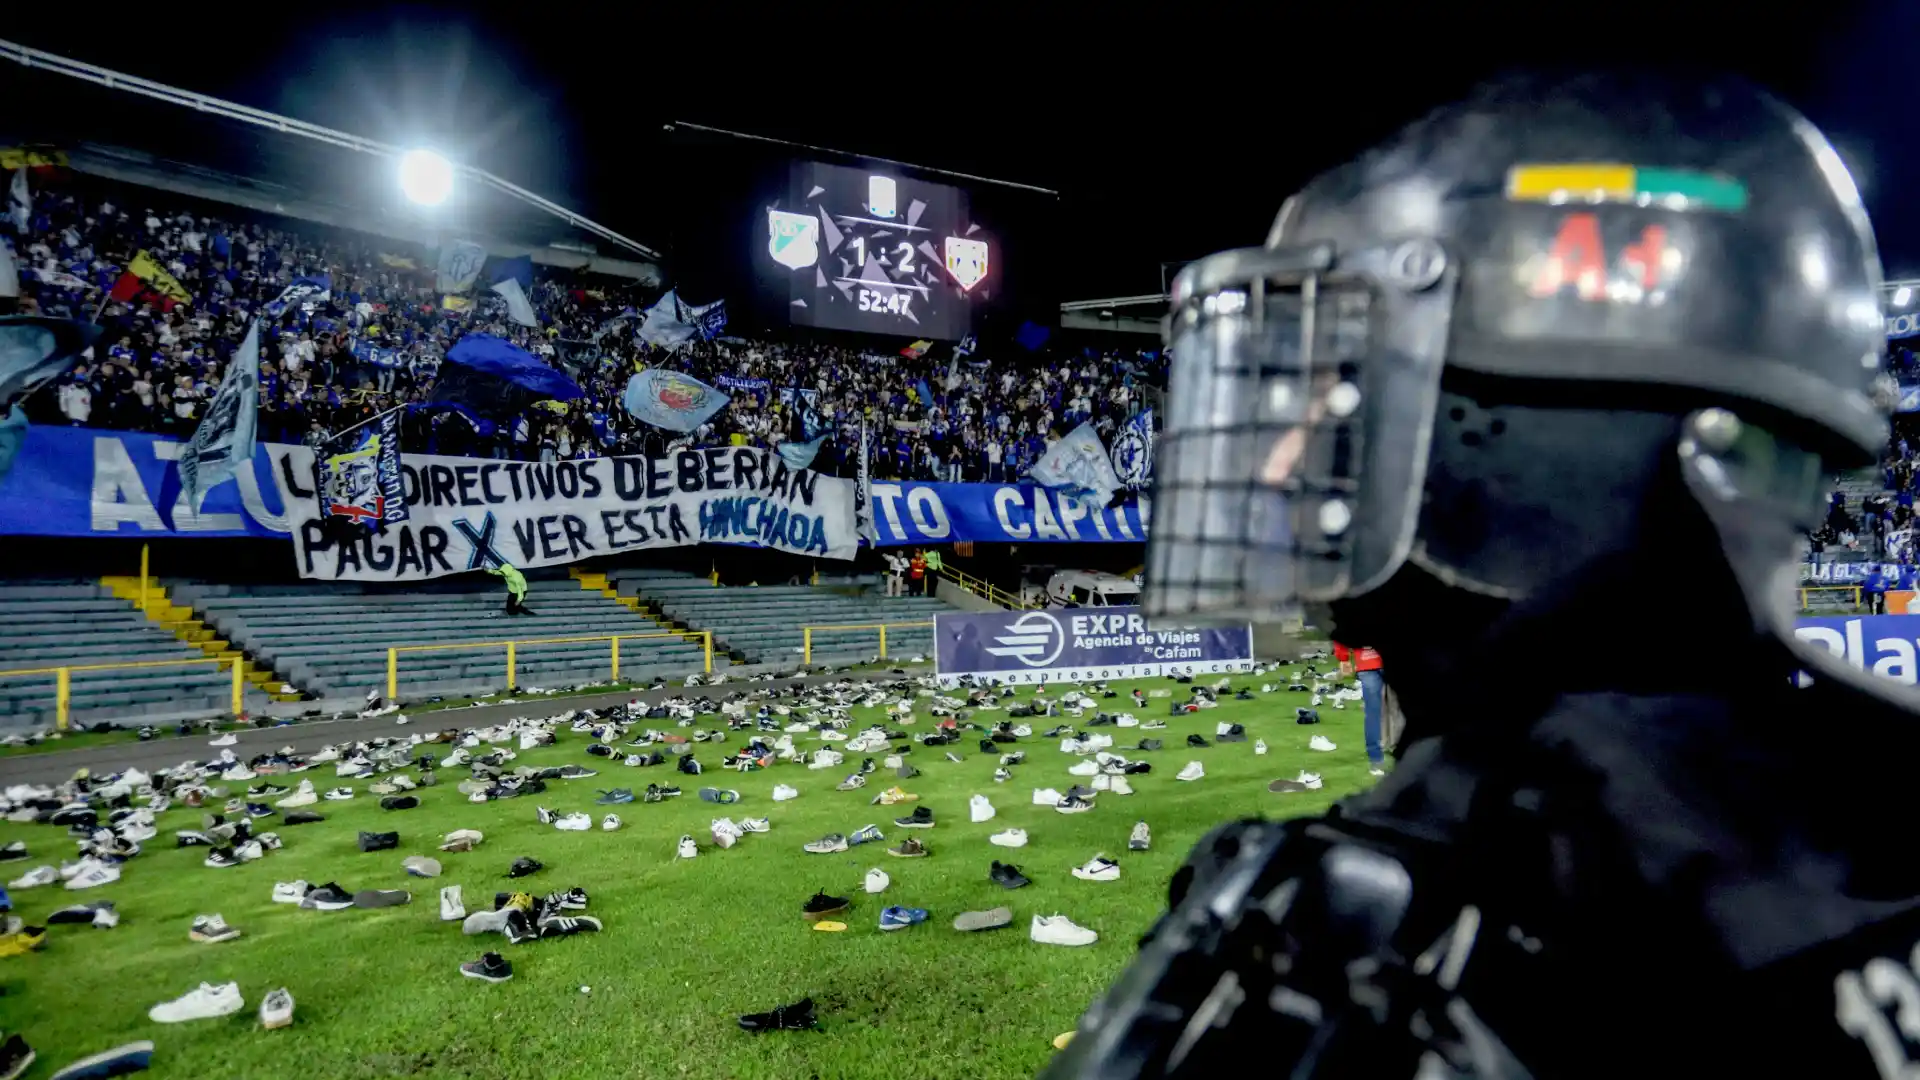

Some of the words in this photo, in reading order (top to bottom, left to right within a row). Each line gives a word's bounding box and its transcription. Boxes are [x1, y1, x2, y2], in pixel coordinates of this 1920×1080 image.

[852, 236, 864, 266] 1
[899, 242, 915, 272] 2
[858, 289, 911, 315] 52:47
[400, 459, 601, 506] DIRECTIVOS
[613, 449, 818, 506] DEBERIAN
[301, 517, 453, 578] PAGAR
[452, 510, 512, 570] X
[513, 512, 595, 563] VER
[600, 502, 690, 548] ESTA
[1074, 633, 1132, 650] Agencia
[1136, 632, 1154, 645] de
[1157, 629, 1200, 645] Viajes
[1154, 646, 1202, 659] Cafam
